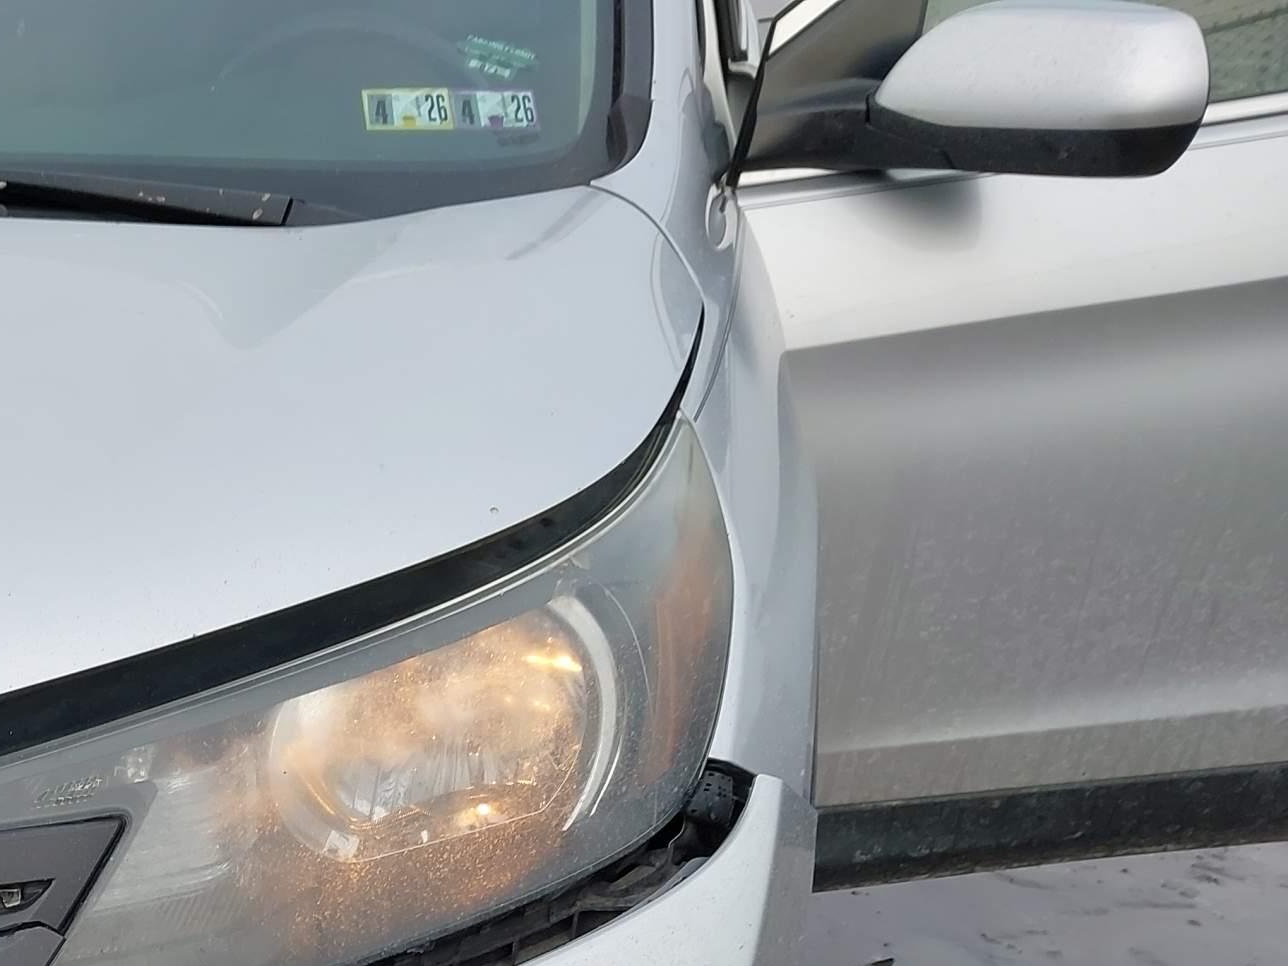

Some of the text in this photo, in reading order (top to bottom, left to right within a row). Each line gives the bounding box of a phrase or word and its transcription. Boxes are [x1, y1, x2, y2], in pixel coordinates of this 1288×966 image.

[375, 94, 448, 125] 4 26
[461, 95, 534, 125] 4 26
